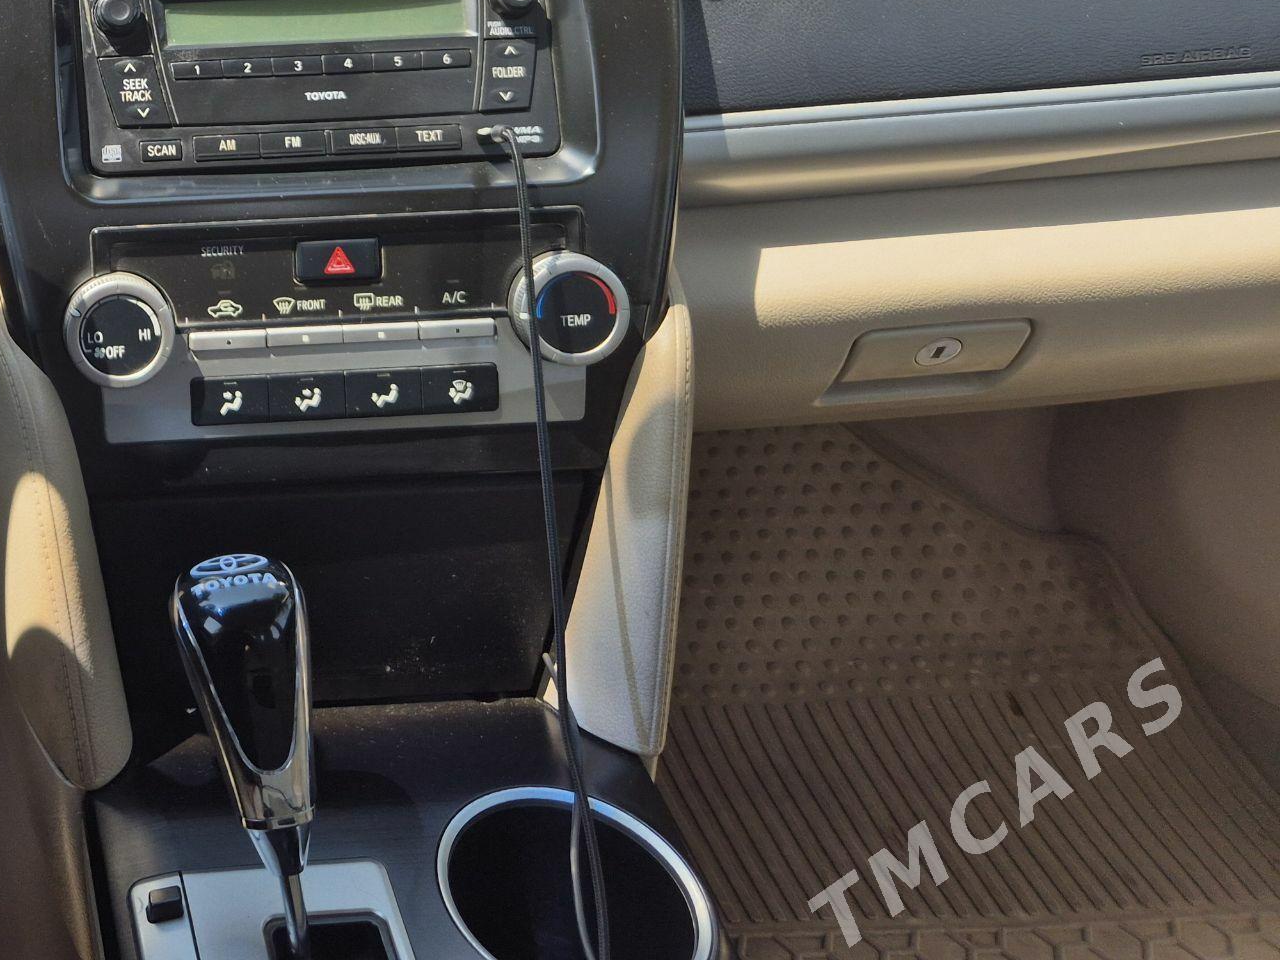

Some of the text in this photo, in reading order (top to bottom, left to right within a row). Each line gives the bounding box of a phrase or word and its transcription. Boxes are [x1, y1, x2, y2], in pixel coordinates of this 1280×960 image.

[343, 58, 353, 69] 4
[393, 56, 403, 67] 5
[442, 53, 453, 65] 6
[194, 64, 200, 76] 1
[243, 62, 252, 74] 2
[293, 60, 303, 72] 3
[491, 66, 526, 79] FOLDER
[122, 78, 149, 90] SEEK
[120, 90, 152, 102] TRACK
[304, 90, 347, 101] TOYOTA
[415, 129, 444, 142] TEXT
[219, 138, 237, 151] AM
[284, 136, 302, 149] FM
[147, 144, 177, 157] SCAN
[200, 245, 245, 257] SECURITY
[375, 295, 403, 307] REAR
[442, 290, 466, 304] A/C
[296, 298, 326, 312] FRONT
[560, 314, 592, 327] TEMP
[87, 331, 104, 344] LO
[138, 328, 151, 342] HI
[105, 345, 125, 360] OFF
[191, 572, 278, 599] TOYOTA
